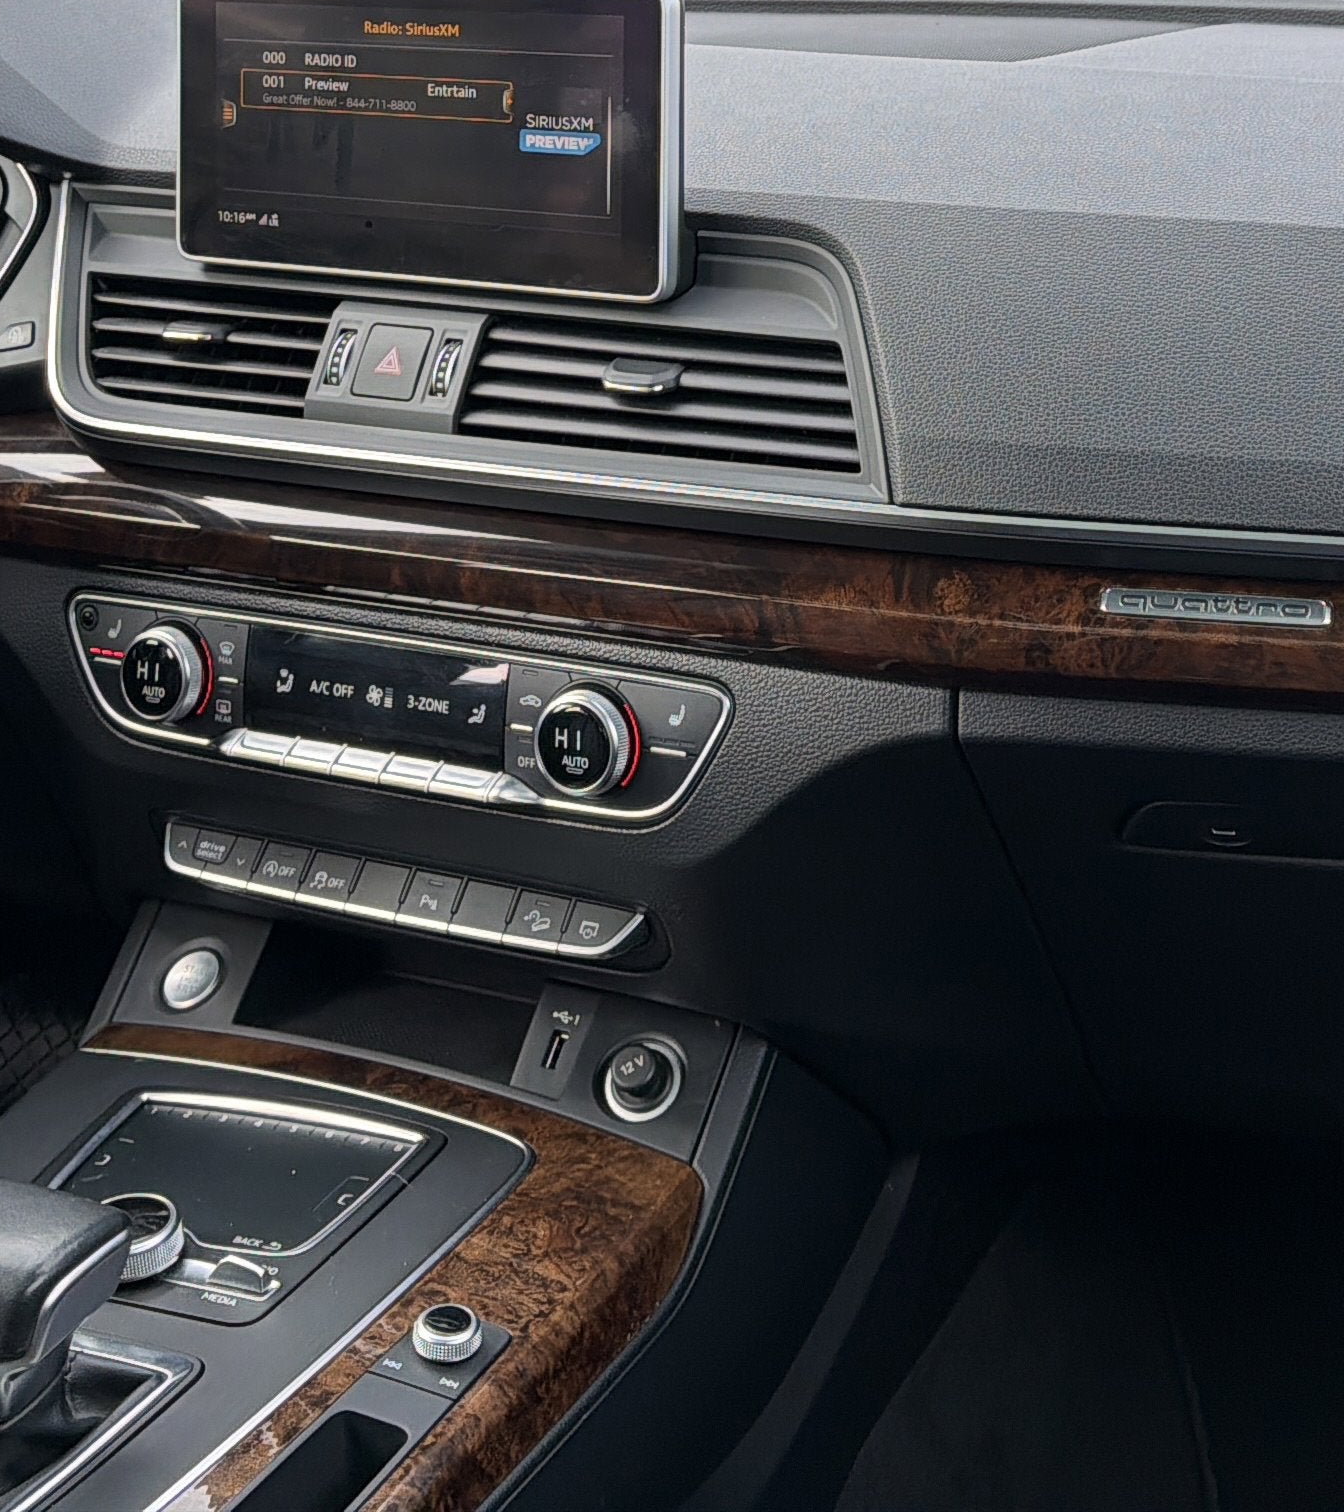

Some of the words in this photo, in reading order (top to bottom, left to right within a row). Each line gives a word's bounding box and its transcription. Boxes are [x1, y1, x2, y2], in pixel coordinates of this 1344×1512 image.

[364, 21, 403, 35] Radio:
[406, 22, 460, 37] SiriusXM
[263, 51, 286, 64] 000
[305, 53, 342, 67] RADIO
[344, 54, 357, 68] ID
[263, 75, 285, 88] 001
[305, 77, 349, 92] Preview
[427, 83, 477, 99] Entrtain
[263, 93, 287, 105] Great
[289, 94, 314, 106] Offer
[316, 95, 338, 108] Now!
[346, 96, 417, 111] 844-711-8800
[525, 113, 594, 131] SIRIUSXM
[525, 134, 594, 150] PREVIEW
[1118, 593, 1312, 618] quattro
[142, 685, 166, 698] AUTO
[309, 679, 331, 694] A/C
[333, 684, 355, 699] OFF
[406, 694, 450, 715] 3-ZONE
[214, 713, 233, 724] REAR
[517, 756, 536, 769] OFF
[562, 758, 589, 769] AUTO
[196, 847, 223, 861] select
[199, 840, 226, 853] drive
[277, 865, 297, 878] OFF
[327, 876, 346, 890] OFF
[620, 1060, 635, 1076] 12
[634, 1054, 645, 1068] V
[232, 1235, 263, 1248] BACK
[200, 1290, 237, 1306] MEDIA
